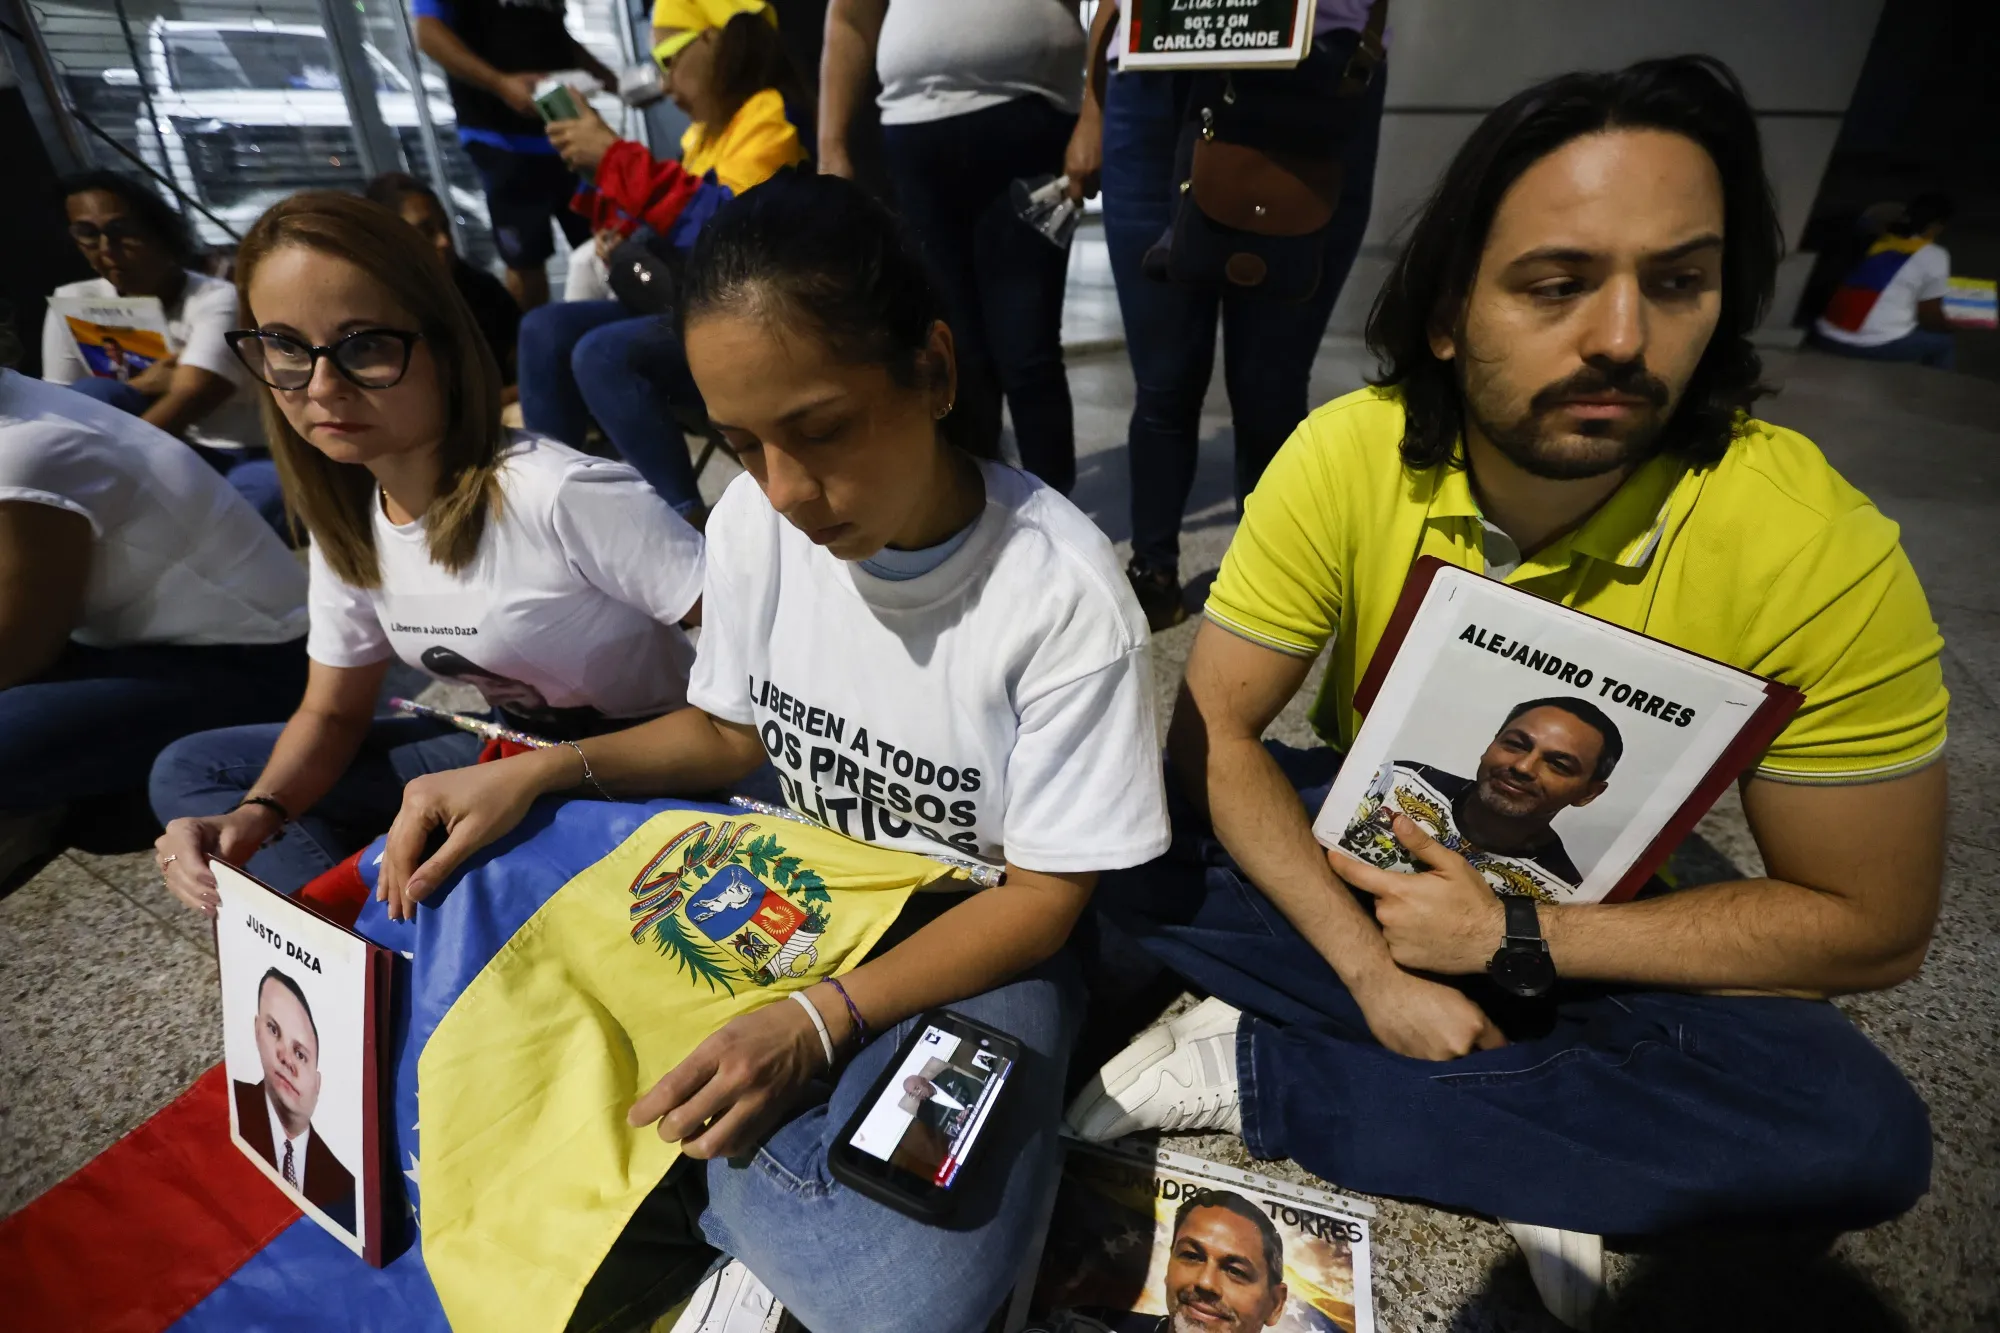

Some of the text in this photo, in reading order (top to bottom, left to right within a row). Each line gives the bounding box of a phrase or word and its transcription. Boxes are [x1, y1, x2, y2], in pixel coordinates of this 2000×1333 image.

[1184, 14, 1249, 30] SGT. 2 GN
[391, 623, 421, 634] Liberen
[430, 625, 454, 636] Justo
[454, 626, 478, 636] Daza
[1458, 623, 1696, 728] ALEJANDRO TORRES
[749, 674, 981, 793] LIBEREN A TODOS
[761, 719, 977, 828] OS PRESOS
[246, 914, 322, 974] JUSTO DAZA
[1263, 1200, 1362, 1243] TORRES
